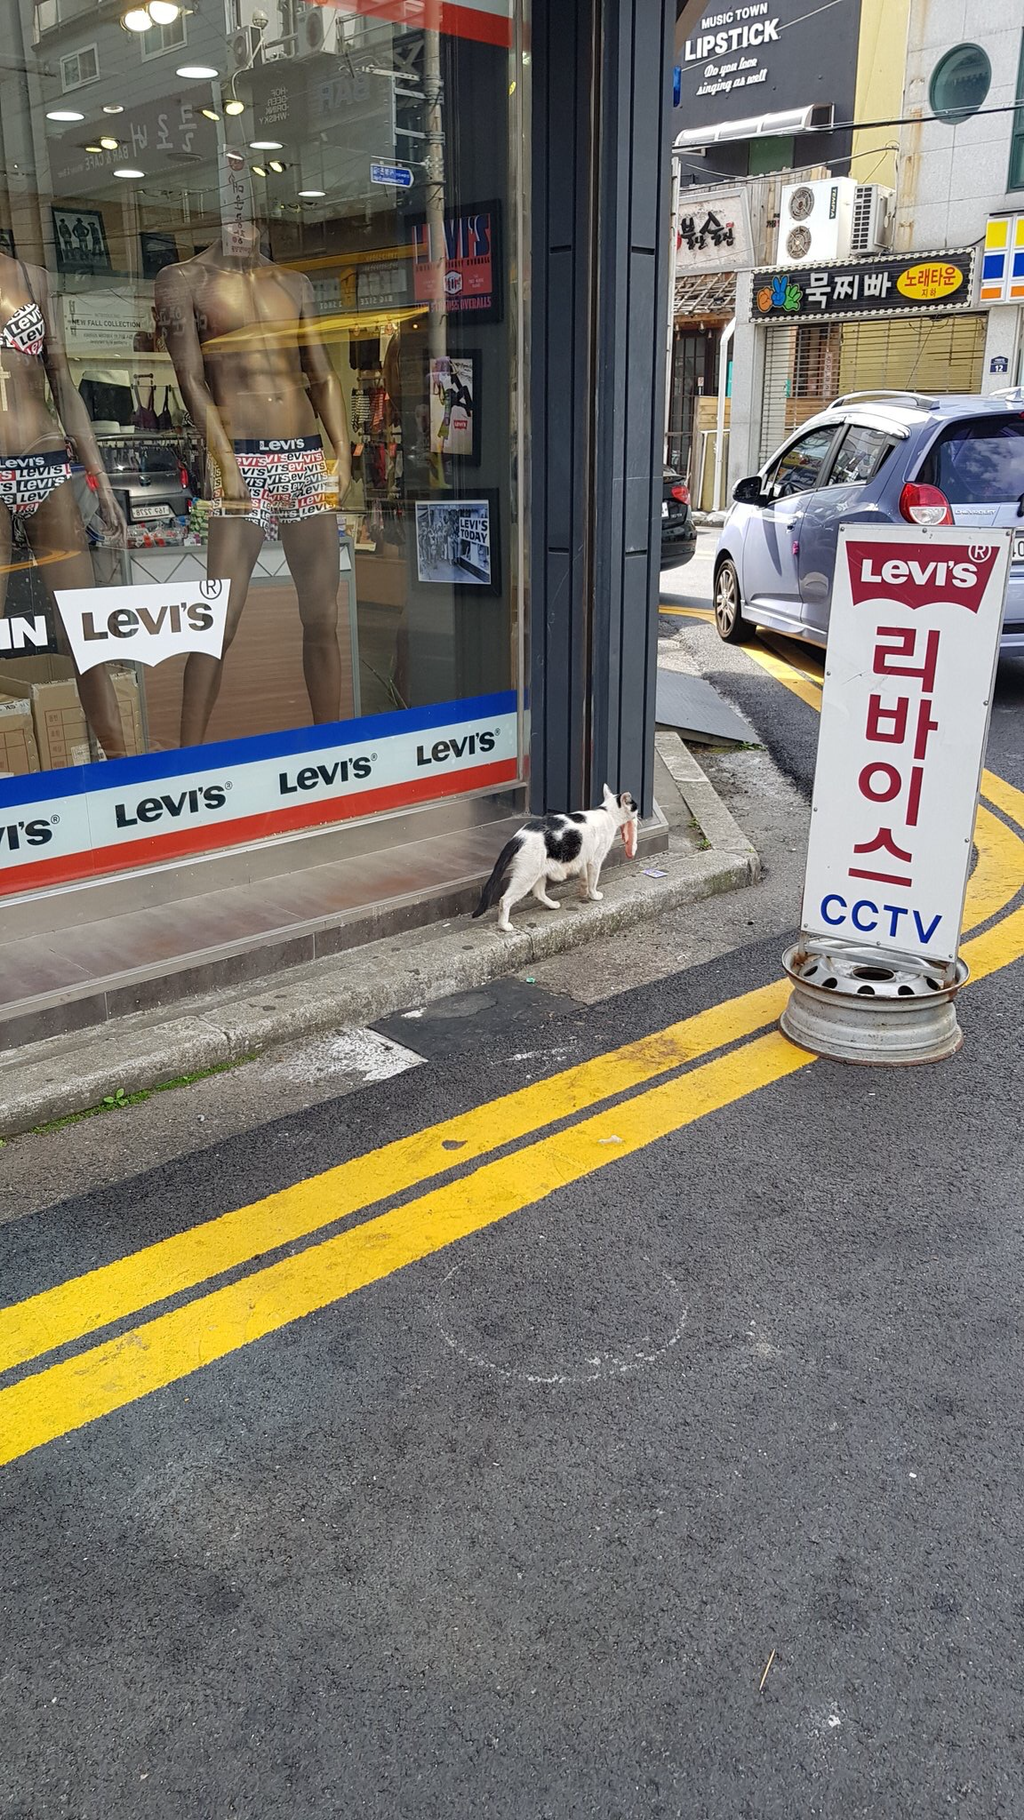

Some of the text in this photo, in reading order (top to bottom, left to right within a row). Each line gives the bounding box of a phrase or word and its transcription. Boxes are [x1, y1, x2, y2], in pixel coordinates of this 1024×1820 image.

[701, 2, 768, 29] MUSIC TOWN
[685, 18, 779, 61] LIPSTICK
[704, 57, 757, 78] Do you love
[696, 68, 767, 95] singing as well
[904, 266, 956, 288] 노래타운
[805, 272, 891, 309] 묵찌빠
[921, 288, 937, 298] 지하
[103, 320, 140, 328] COLLECTION
[460, 519, 488, 532] LEVI'S
[460, 529, 488, 544] TODAY
[848, 626, 940, 887] 리바이스
[821, 894, 943, 945] CCTV
